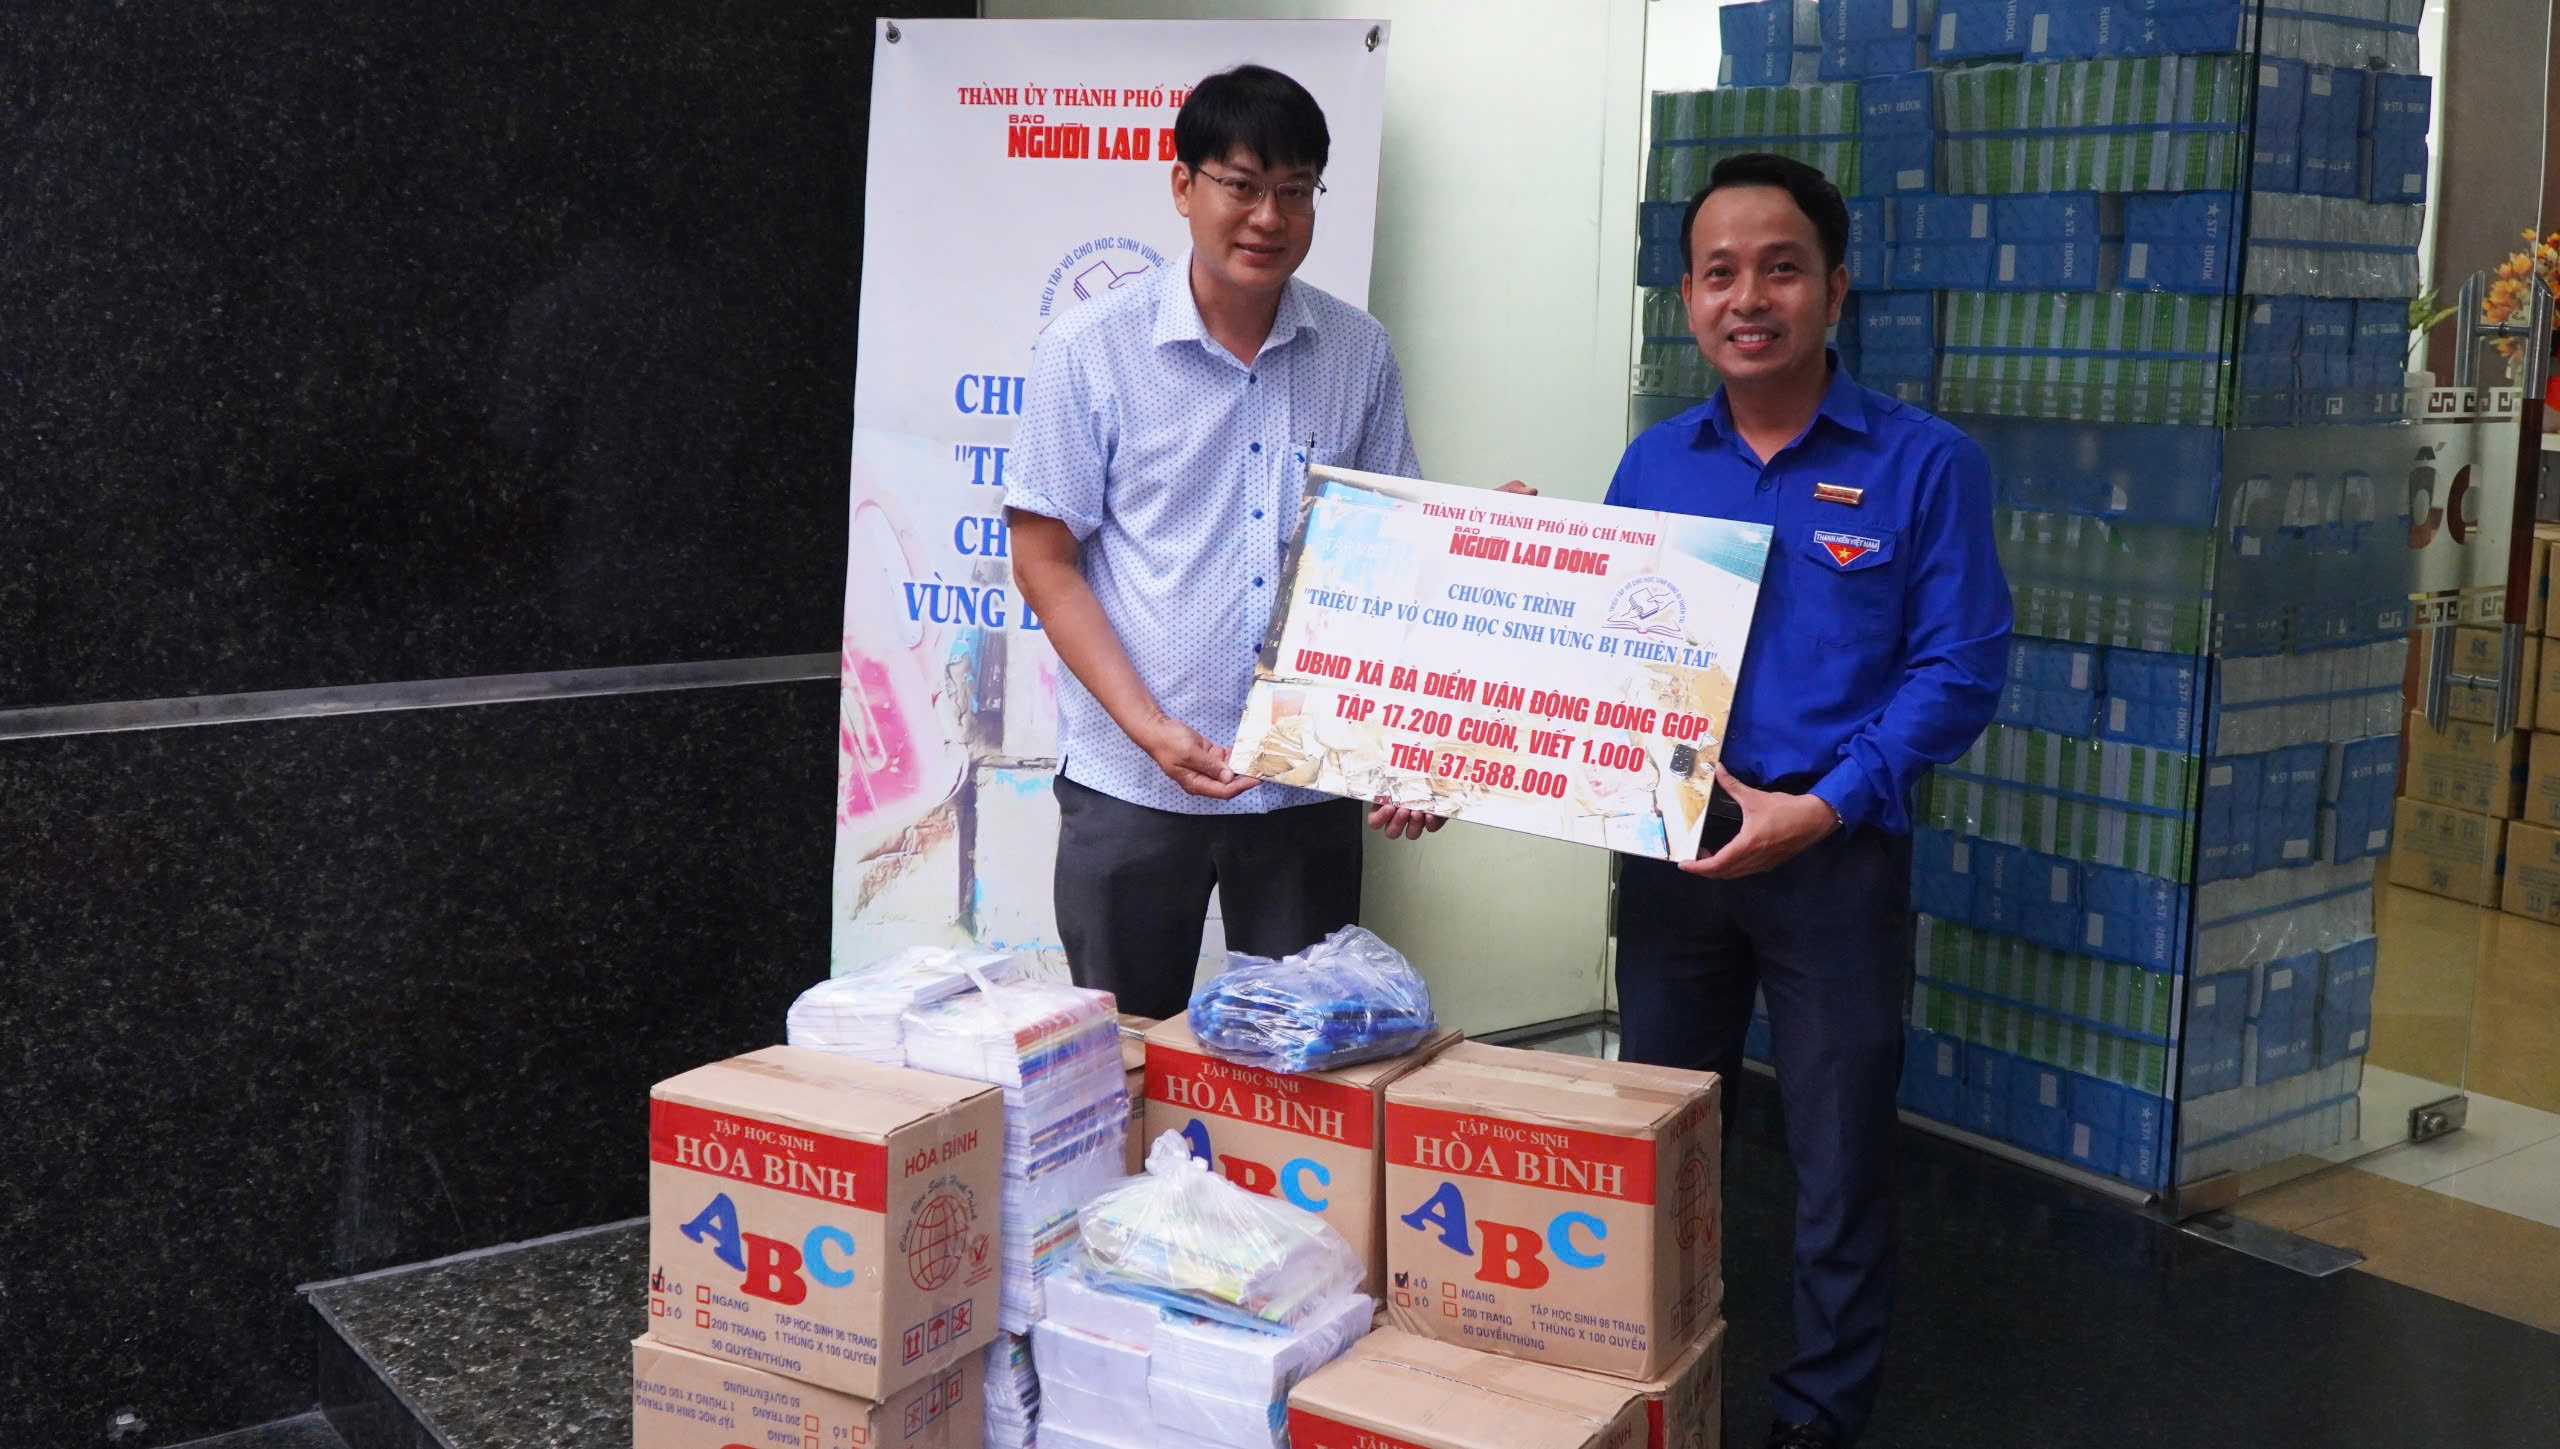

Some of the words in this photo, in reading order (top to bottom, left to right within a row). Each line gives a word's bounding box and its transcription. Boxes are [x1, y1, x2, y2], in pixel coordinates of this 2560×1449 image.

[957, 81, 1018, 105] THÀNH
[1024, 82, 1048, 106] ỦY
[1053, 82, 1117, 107] THÀNH
[1122, 83, 1164, 108] PHỐ
[1009, 114, 1045, 124] BÁO
[1008, 122, 1091, 160] NGƯỜI
[1098, 127, 1151, 161] LAO
[1073, 242, 1093, 260] CHO
[1117, 237, 1140, 252] SINH
[1422, 502, 1467, 521] THÀNH
[1469, 507, 1486, 523] ỦY
[1489, 511, 1534, 530] THÀNH
[1537, 517, 1566, 534] PHỐ
[1568, 521, 1589, 537] HỒ
[1592, 525, 1618, 541] CHÍ
[1619, 530, 1657, 546] MINH
[1449, 532, 1510, 562] NGƯỜI
[1511, 542, 1551, 567] LAO
[1554, 547, 1610, 576] ĐỘNG
[904, 571, 1005, 628] VÙNG
[1448, 583, 1518, 610] CHƯƠNG
[1522, 591, 1576, 618] TRÌNH
[1362, 596, 1393, 618] TẬP
[1397, 599, 1420, 622] VỞ
[1423, 608, 1458, 628] CHO
[1462, 614, 1499, 636] HỌC
[1502, 621, 1545, 643] SINH
[1550, 625, 1594, 651] VÙNG
[1599, 635, 1620, 658] BỊ
[1623, 640, 1678, 663] THIÊN
[1295, 648, 1352, 680] UBND
[1355, 659, 1385, 687] XÃ
[1389, 664, 1418, 693] BÀ
[1423, 669, 1477, 703] ĐIỂM
[1481, 681, 1525, 713] VẬN
[1528, 689, 1590, 722] ĐỘNG
[1594, 700, 1657, 734] ĐÓNG
[1661, 711, 1709, 742] GÓP
[1335, 693, 1376, 724] TẬP
[1382, 703, 1453, 738] 17.200
[1457, 716, 1519, 753] CUỐN,
[1529, 728, 1576, 760] VIẾT
[1582, 739, 1646, 772] 1.000
[1390, 741, 1434, 774] TIỀN
[1438, 752, 1568, 799] 37.588.000
[1202, 1062, 1229, 1079] TẬP
[1232, 1069, 1263, 1086] HỌC
[1265, 1074, 1299, 1093] SINH
[1166, 1073, 1243, 1118] HÒA
[1254, 1088, 1345, 1141] BÌNH
[714, 1119, 741, 1138] TẬP
[745, 1127, 775, 1147] HỌC
[778, 1133, 816, 1152] SINH
[904, 1147, 937, 1178] HÒA
[942, 1130, 978, 1162] BÌNH
[1457, 1119, 1486, 1138] TẬP
[1493, 1125, 1525, 1144] HỌC
[1530, 1131, 1570, 1149] SINH
[675, 1133, 751, 1179] HÒA
[764, 1150, 856, 1202] BÌNH
[1414, 1131, 1504, 1177] HÒA
[1515, 1145, 1625, 1196] BÌNH
[680, 1192, 856, 1306] ABC
[1401, 1181, 1608, 1289] ABC
[712, 1294, 750, 1313] NGANG
[1461, 1288, 1496, 1304] NGANG
[1462, 1307, 1478, 1319] 200
[1480, 1311, 1513, 1326] TRANG
[711, 1318, 728, 1331] 200
[731, 1322, 767, 1342] TRANG
